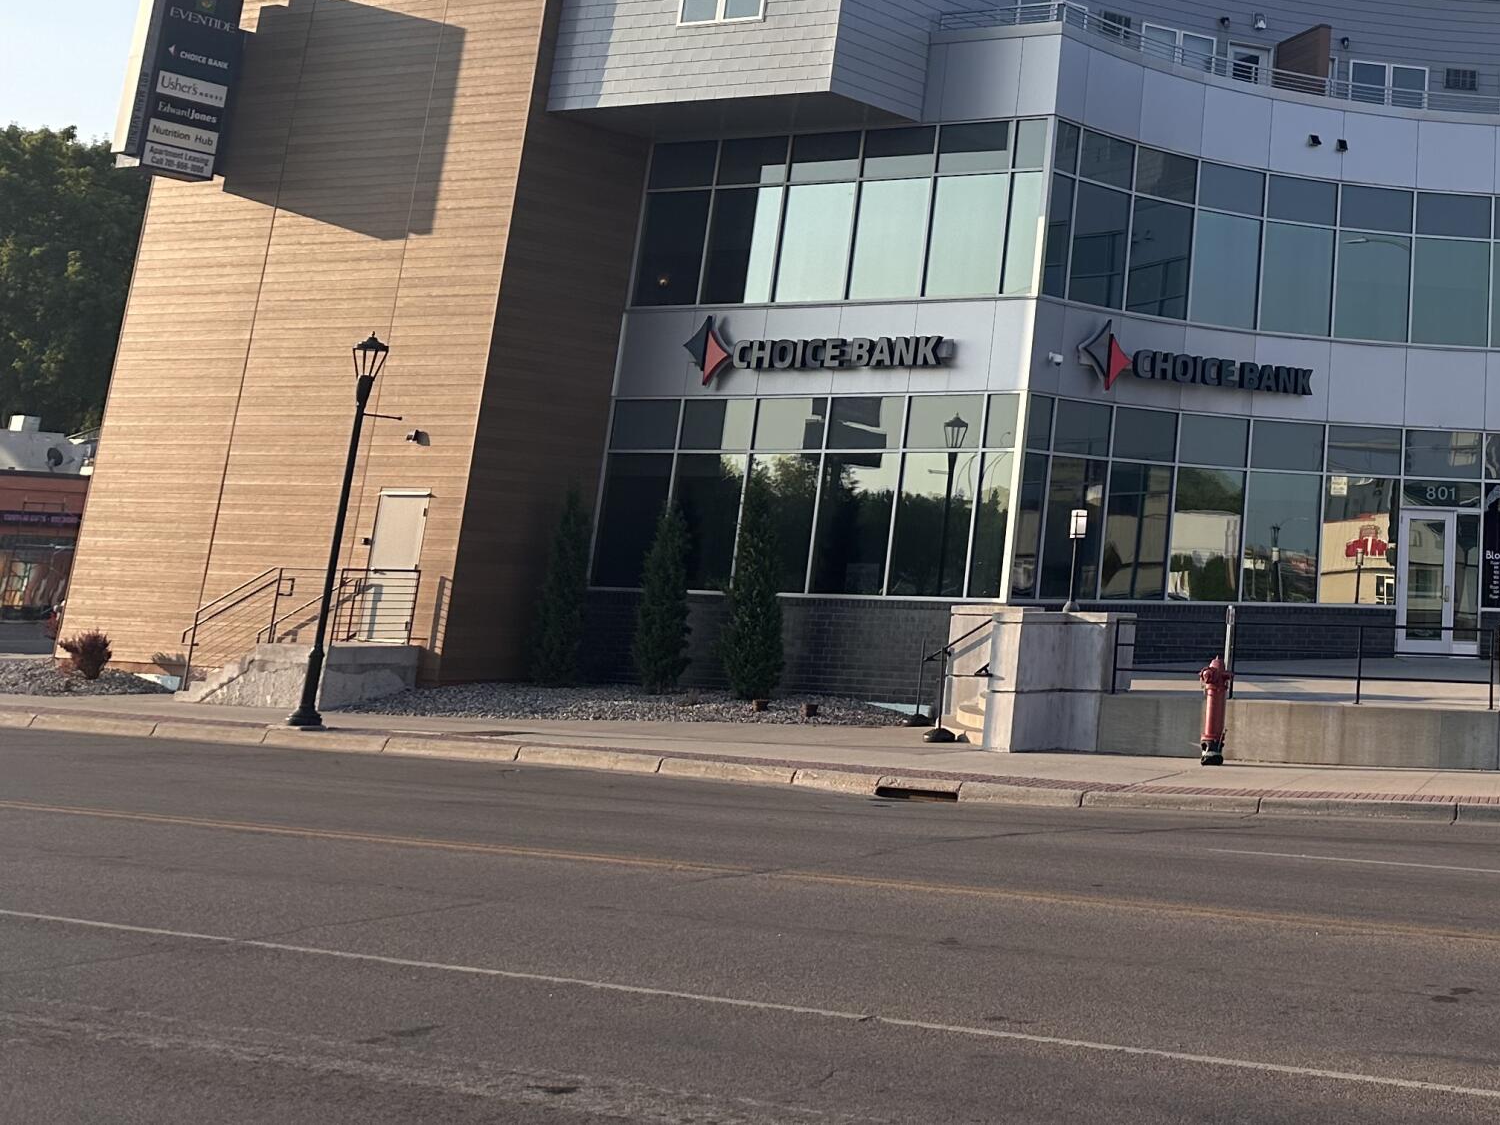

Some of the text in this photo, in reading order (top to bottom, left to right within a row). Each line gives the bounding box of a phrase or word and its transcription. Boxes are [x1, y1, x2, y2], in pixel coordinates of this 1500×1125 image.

[169, 6, 236, 34] EVENTIDE
[179, 50, 229, 70] CHOICE BANK
[152, 124, 214, 146] Nutrition Hub
[732, 335, 943, 370] CHOICE BANK
[1133, 349, 1313, 396] CHOICE BANK
[1426, 486, 1456, 501] 801
